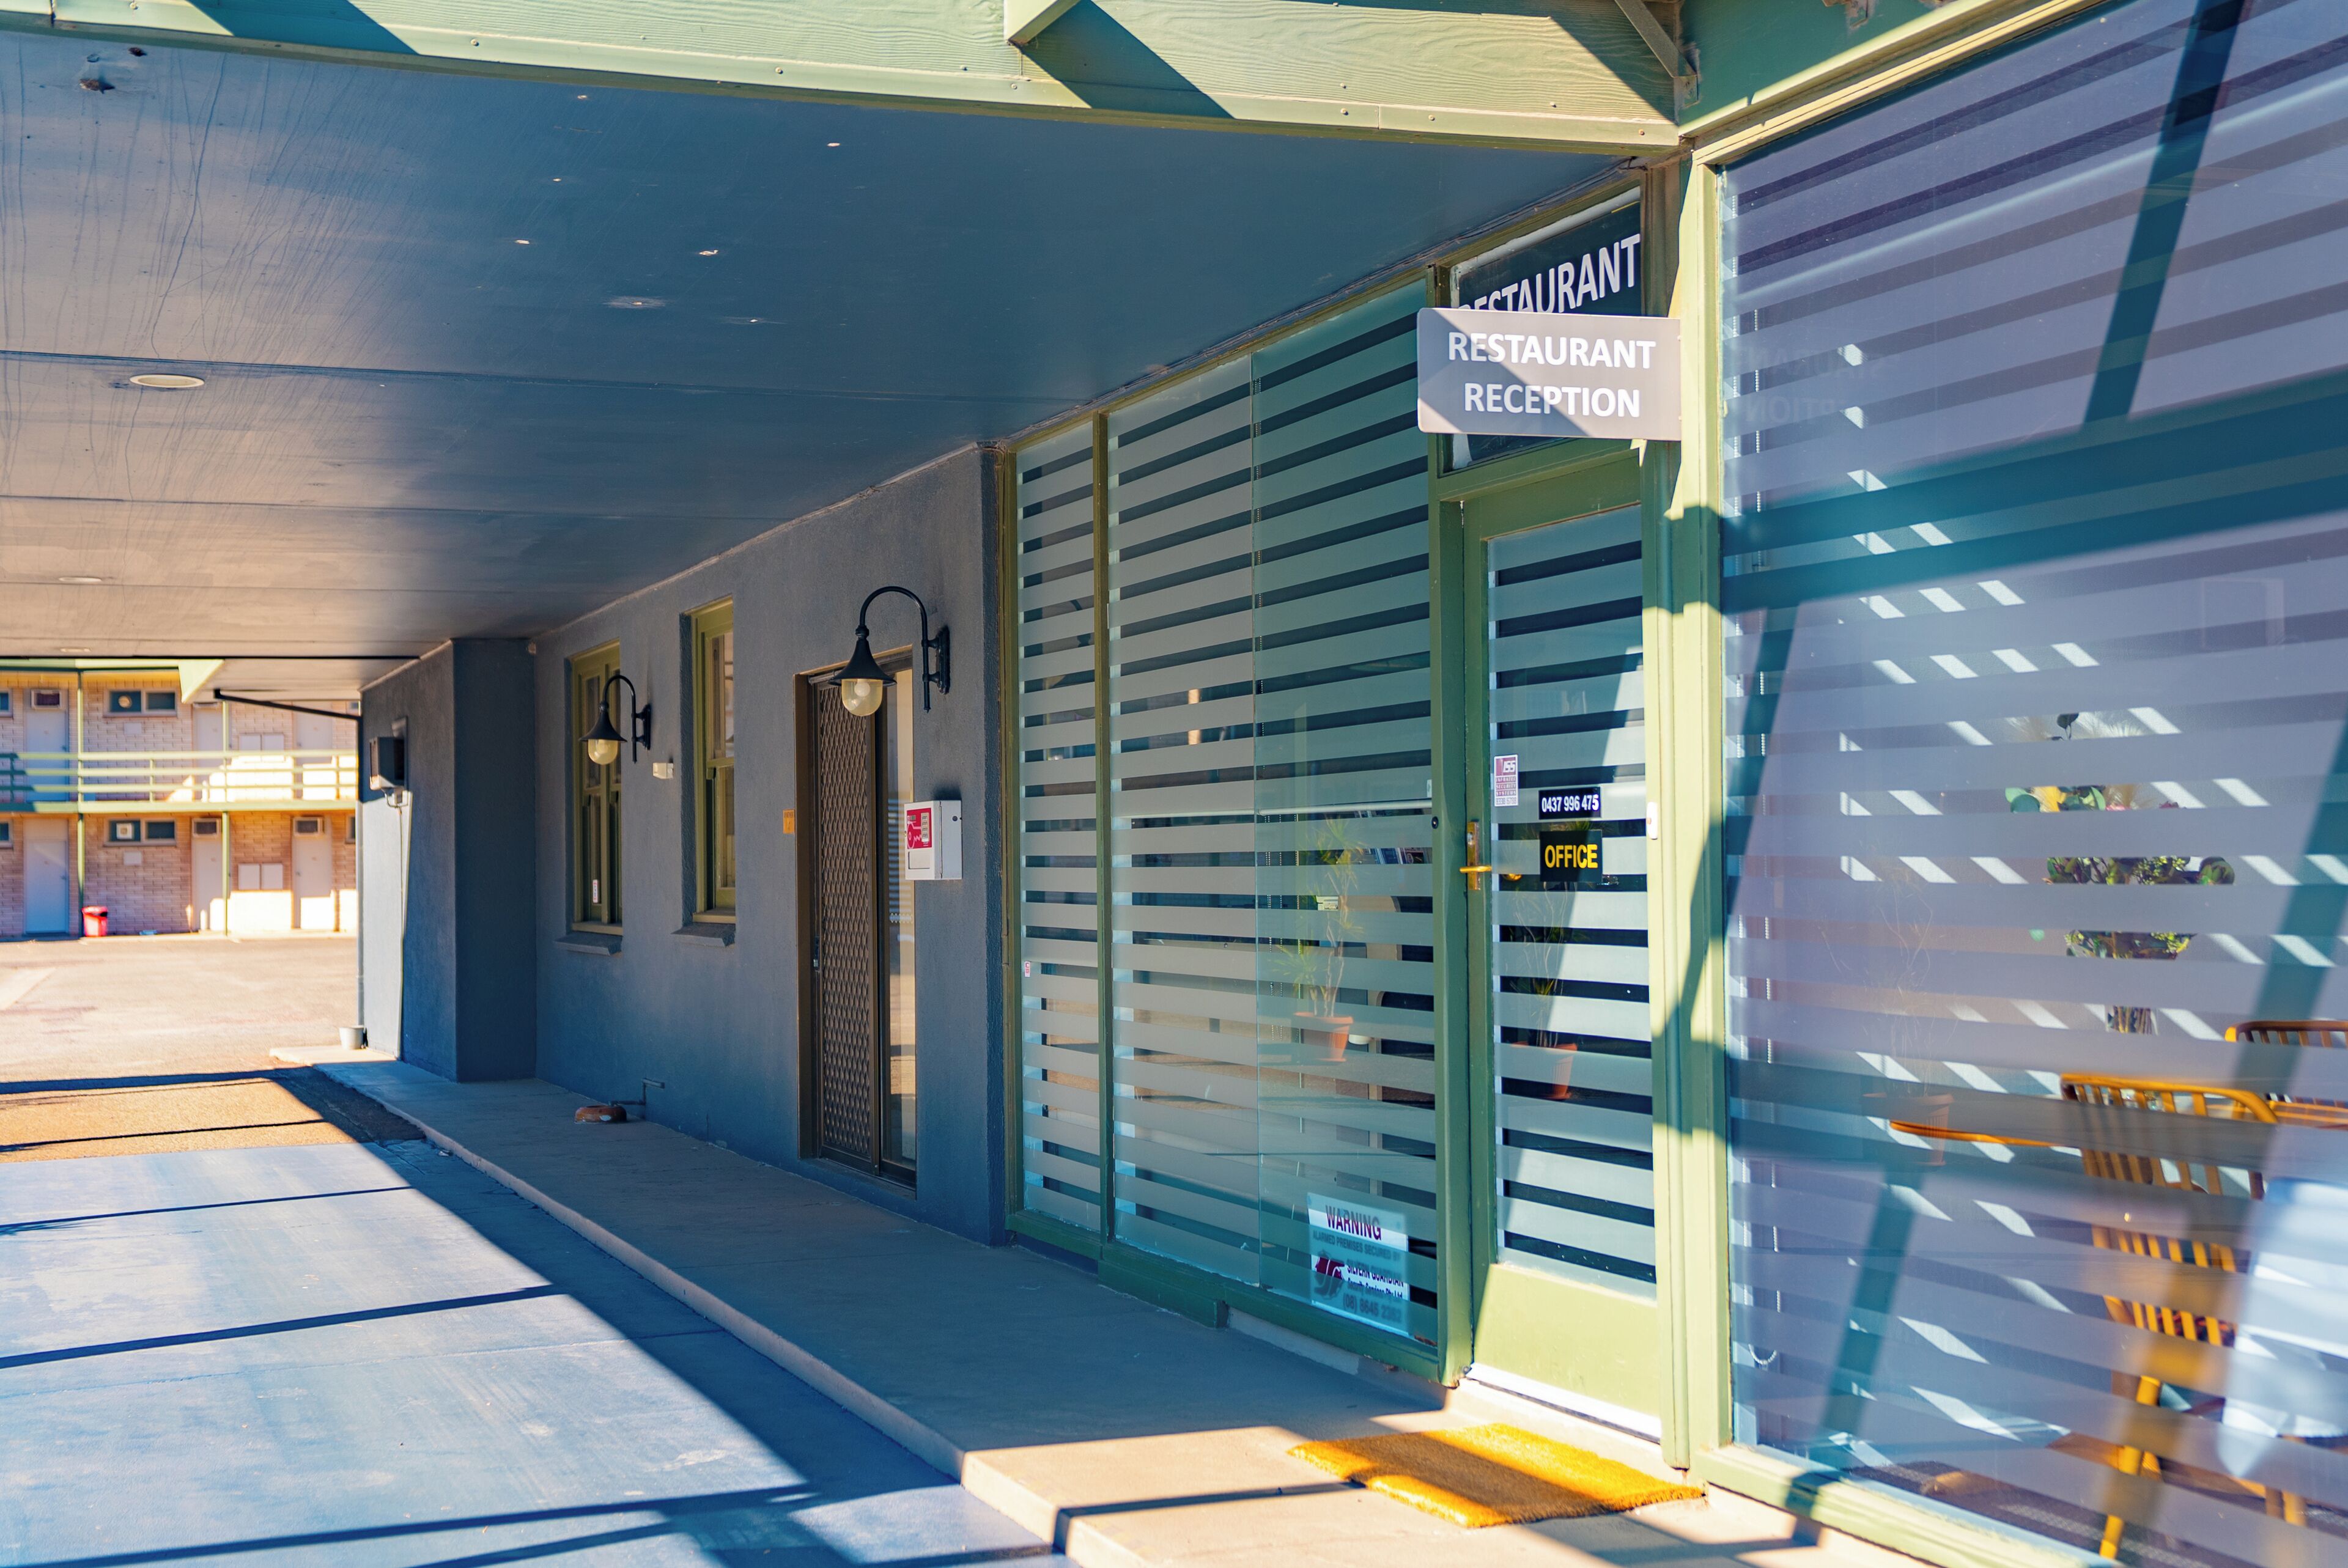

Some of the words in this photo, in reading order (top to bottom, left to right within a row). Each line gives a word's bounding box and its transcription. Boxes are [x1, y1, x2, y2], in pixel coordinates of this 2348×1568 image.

[1458, 234, 1641, 314] TAURANT
[1448, 332, 1656, 369] RESTAURANT
[1464, 383, 1640, 418] RECEPTION
[1541, 797, 1562, 812] 0437
[1563, 795, 1581, 812] 996
[1581, 794, 1599, 811] 475
[1545, 844, 1598, 869] OFFICE
[1325, 1205, 1381, 1240] WARNING
[1313, 1230, 1335, 1245] ALARMED
[1336, 1236, 1363, 1253] PREMISES
[1364, 1243, 1391, 1259] SECURED
[1371, 1265, 1404, 1287] GUARDIAN
[1343, 1292, 1357, 1314] (08)
